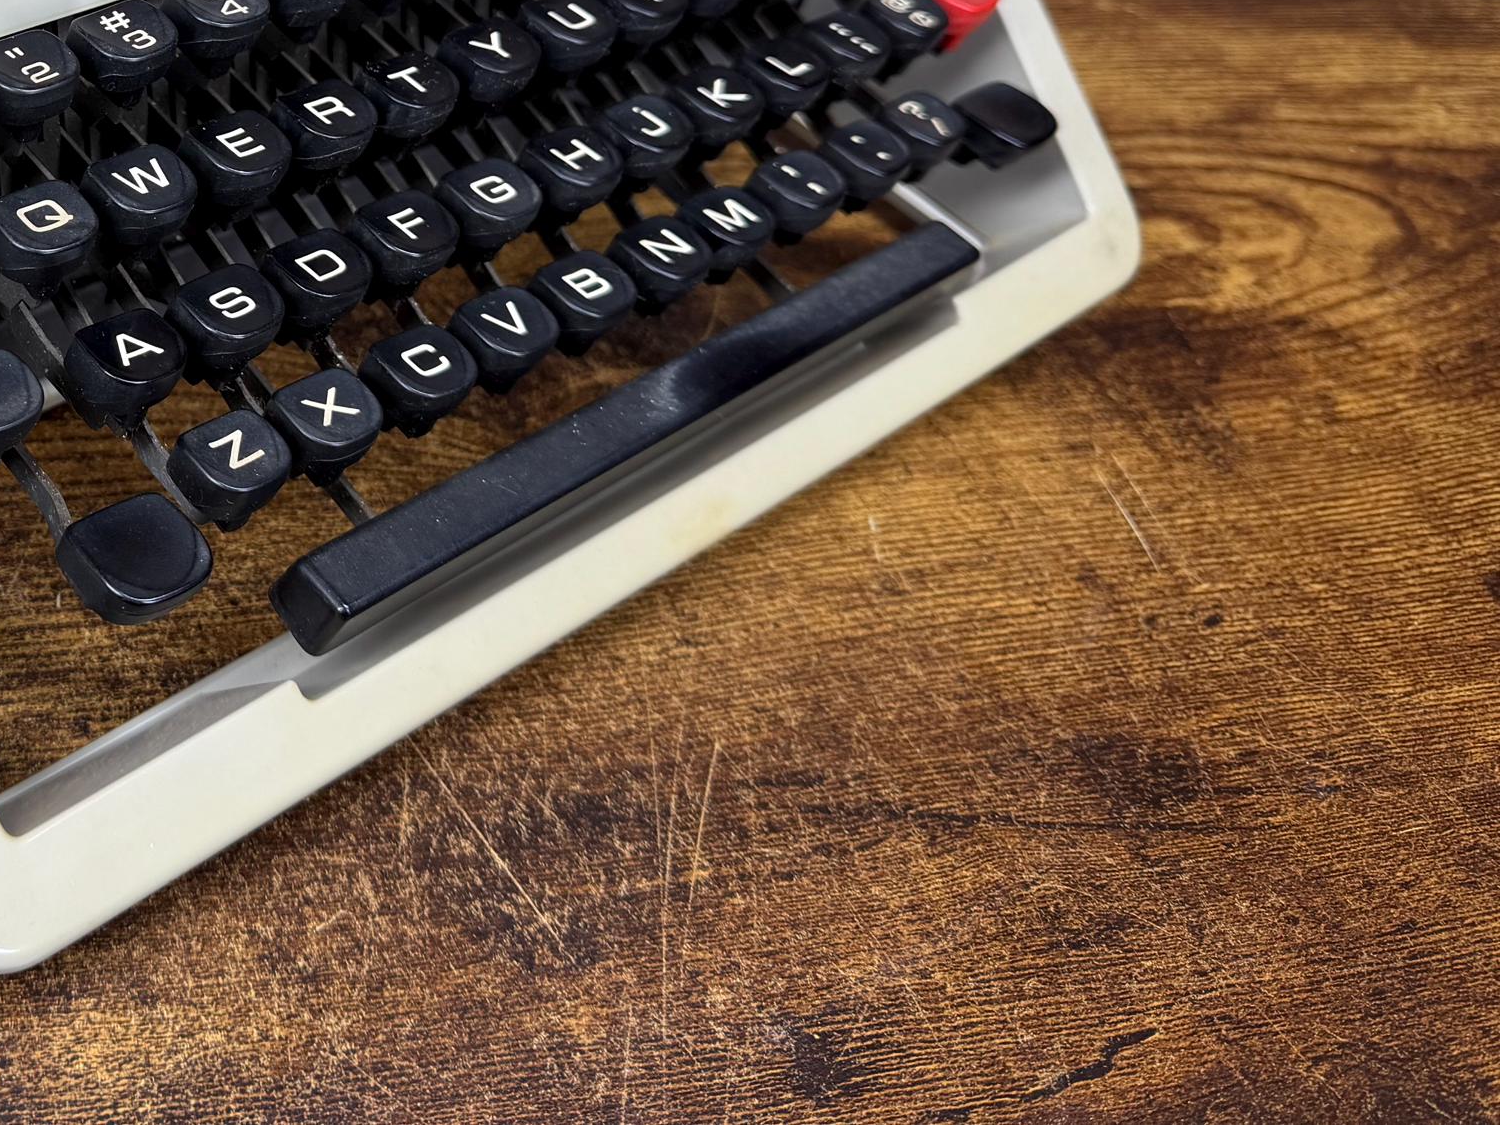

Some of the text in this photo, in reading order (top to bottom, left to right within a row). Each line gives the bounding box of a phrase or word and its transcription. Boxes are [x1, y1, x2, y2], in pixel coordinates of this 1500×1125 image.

[99, 10, 131, 34] #
[547, 3, 596, 30] U
[121, 24, 157, 50] 3
[468, 31, 511, 58] Y
[20, 61, 60, 84] 2
[386, 66, 427, 93] T
[765, 56, 812, 77] L
[696, 78, 749, 108] K
[303, 96, 356, 125] R
[631, 106, 670, 137] J
[215, 127, 266, 158] E
[549, 138, 604, 171] H
[111, 157, 170, 195] W
[469, 175, 518, 204] G
[16, 199, 74, 233] Q
[386, 207, 424, 240] F
[702, 198, 760, 232] M
[638, 228, 695, 263] N
[294, 249, 347, 282] D
[561, 268, 613, 300] B
[208, 286, 257, 319] S
[480, 300, 528, 335] V
[115, 333, 165, 367] A
[400, 343, 451, 377] C
[300, 386, 361, 427] X
[208, 429, 266, 470] Z
